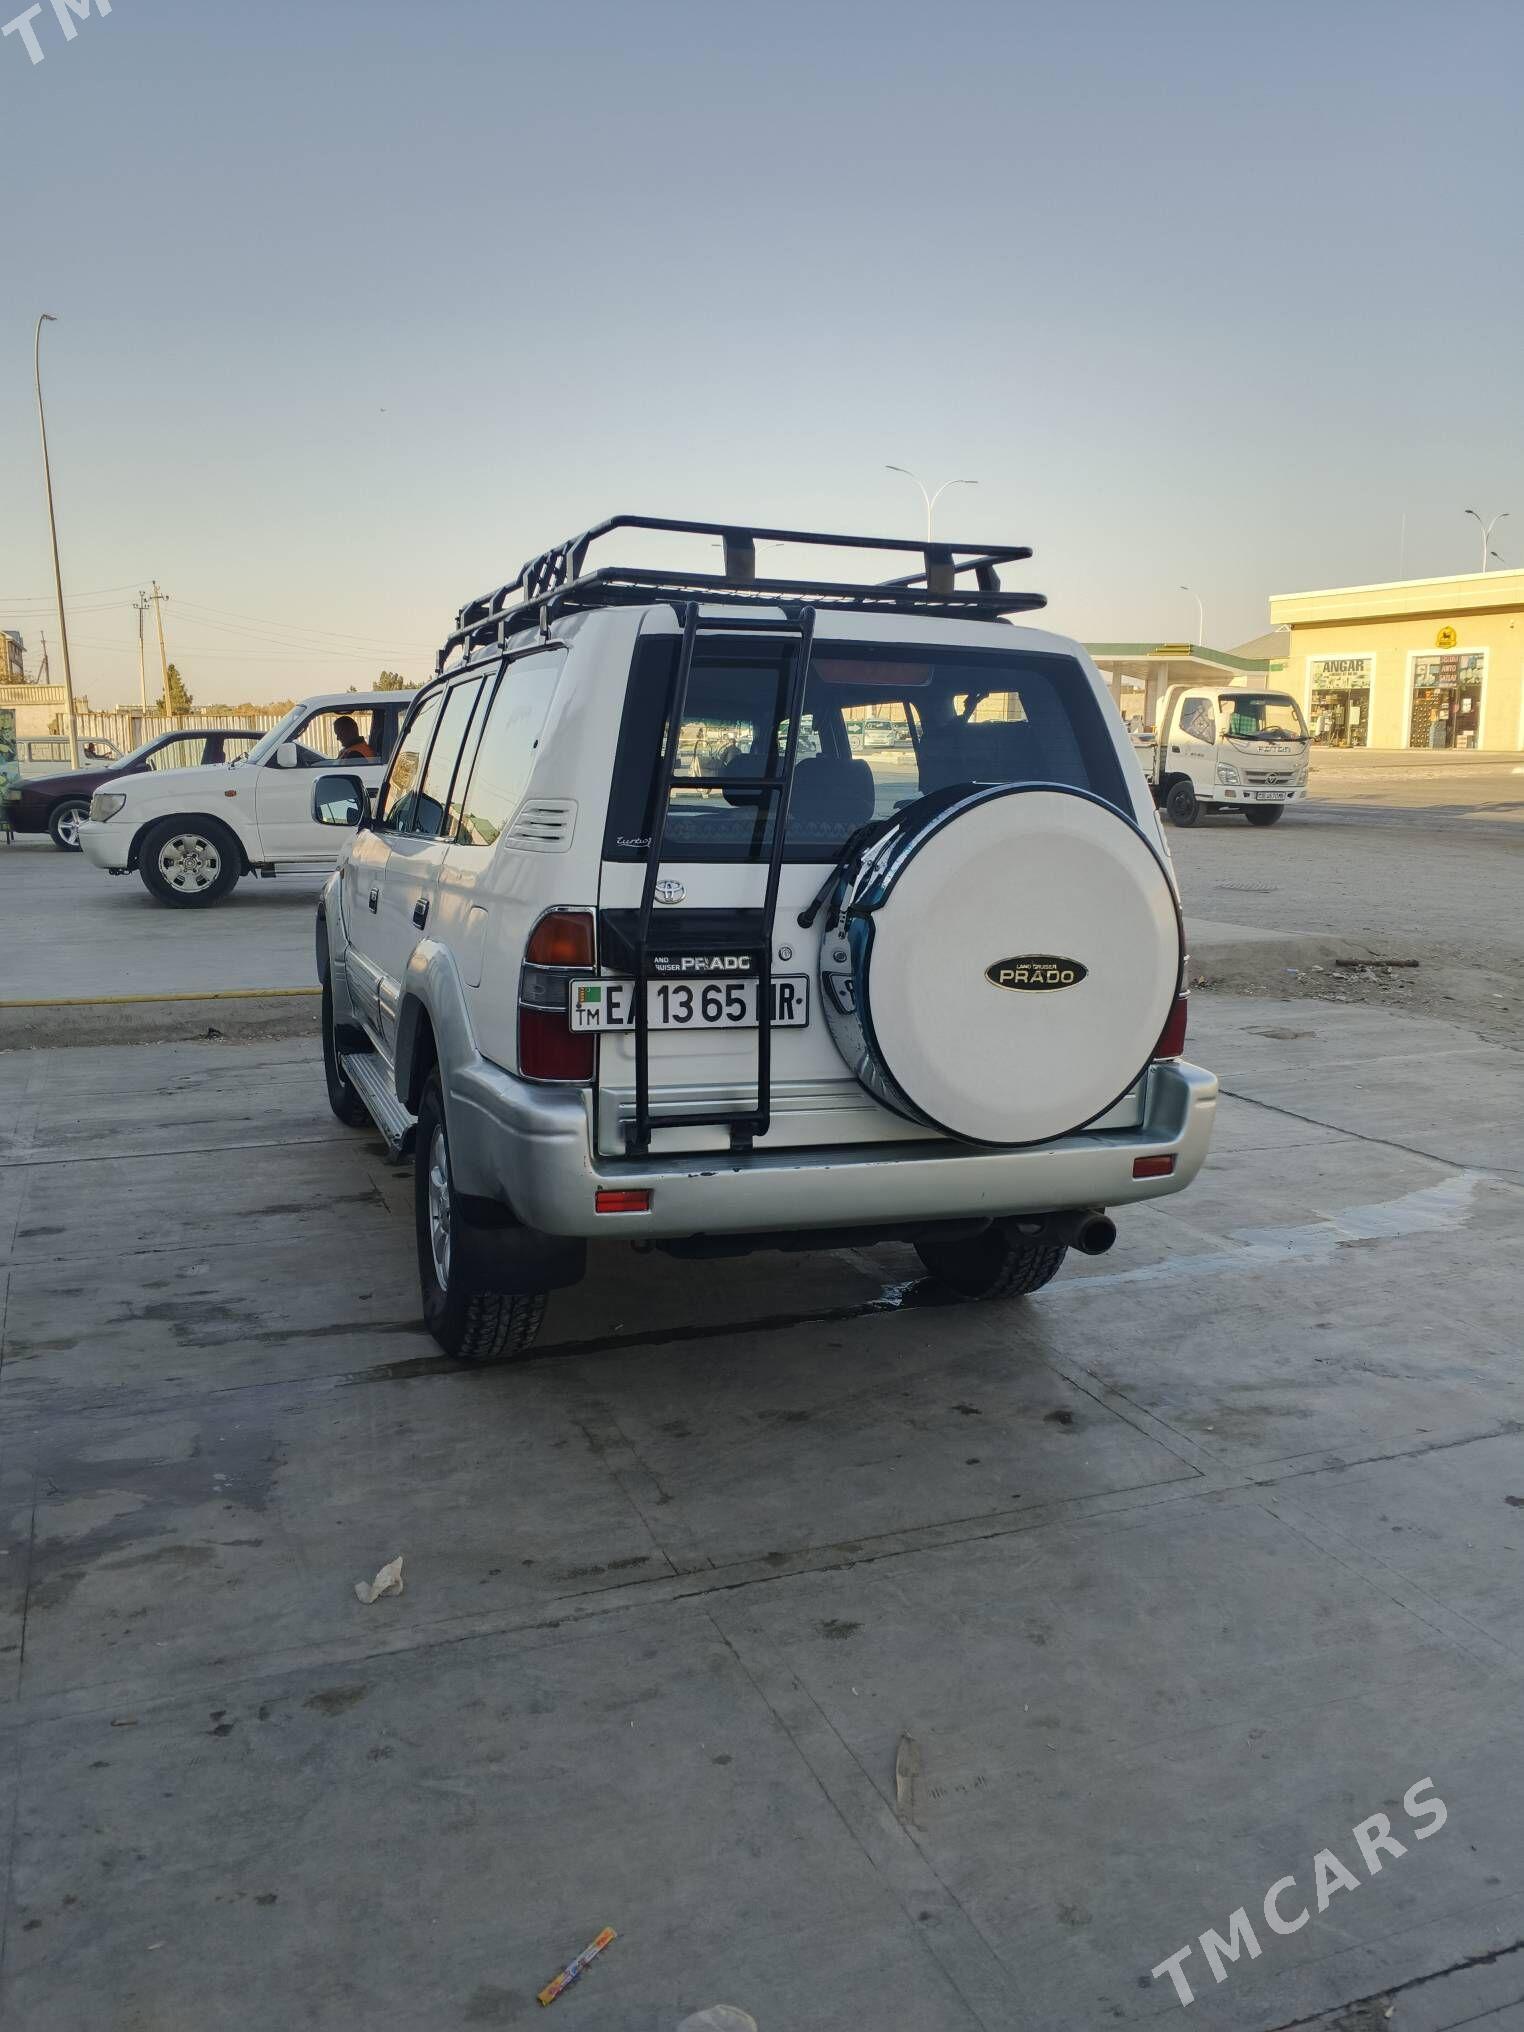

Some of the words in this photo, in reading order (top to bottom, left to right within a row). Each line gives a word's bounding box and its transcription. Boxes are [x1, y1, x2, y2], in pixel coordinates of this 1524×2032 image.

[1323, 660, 1364, 672] ANGAR
[1000, 969, 1074, 984] PRADO
[657, 984, 747, 1024] 1365
[576, 1009, 600, 1026] TM
